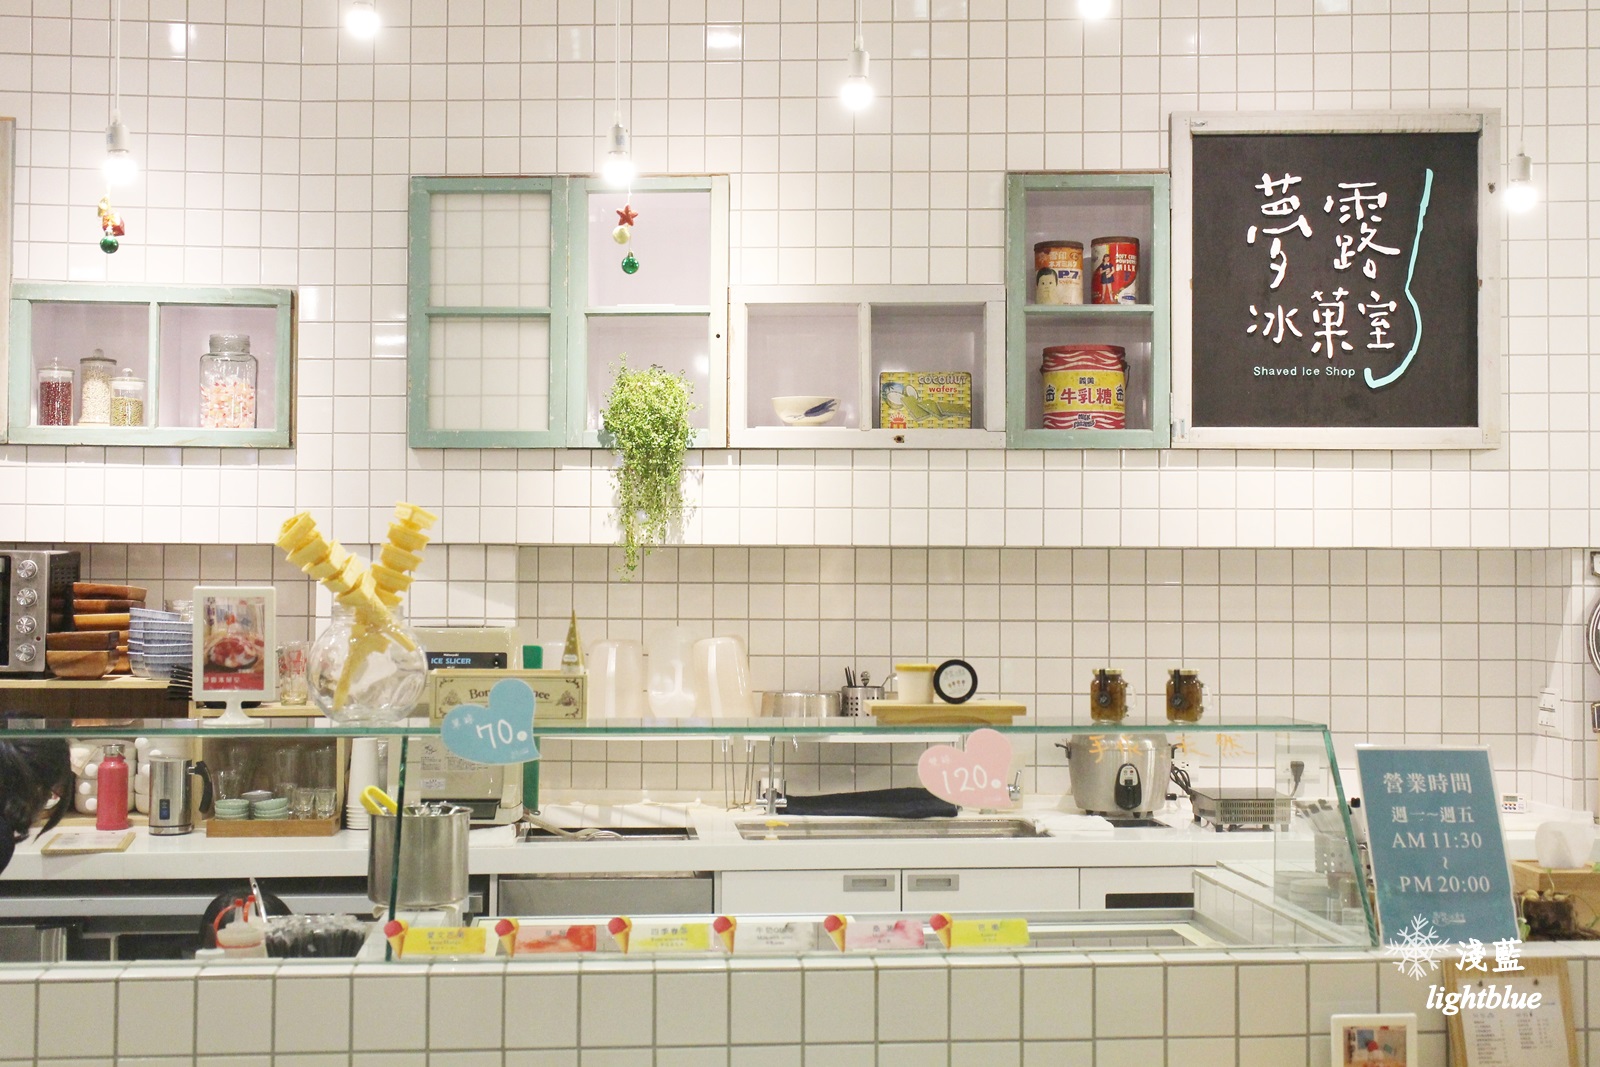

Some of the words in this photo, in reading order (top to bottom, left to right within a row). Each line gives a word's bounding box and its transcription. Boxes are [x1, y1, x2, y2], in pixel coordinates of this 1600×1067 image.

[1247, 173, 1401, 288] 夢露
[1057, 270, 1079, 280] P7
[1116, 264, 1136, 272] MILK
[1247, 288, 1397, 359] 冰菓室
[1253, 366, 1297, 376] Shaved
[1302, 366, 1320, 376] Ice
[1325, 366, 1356, 379] Shop
[918, 375, 968, 385] COCONUT
[929, 385, 958, 393] wafers
[1061, 388, 1112, 405] 牛乳糖
[430, 657, 443, 665] ICE
[445, 657, 472, 665] SLICER
[1383, 772, 1473, 793] 營業時間
[1392, 832, 1427, 848] AM
[1432, 832, 1483, 848] 11:30
[1399, 875, 1433, 893] PM
[1437, 875, 1491, 893] 20:00
